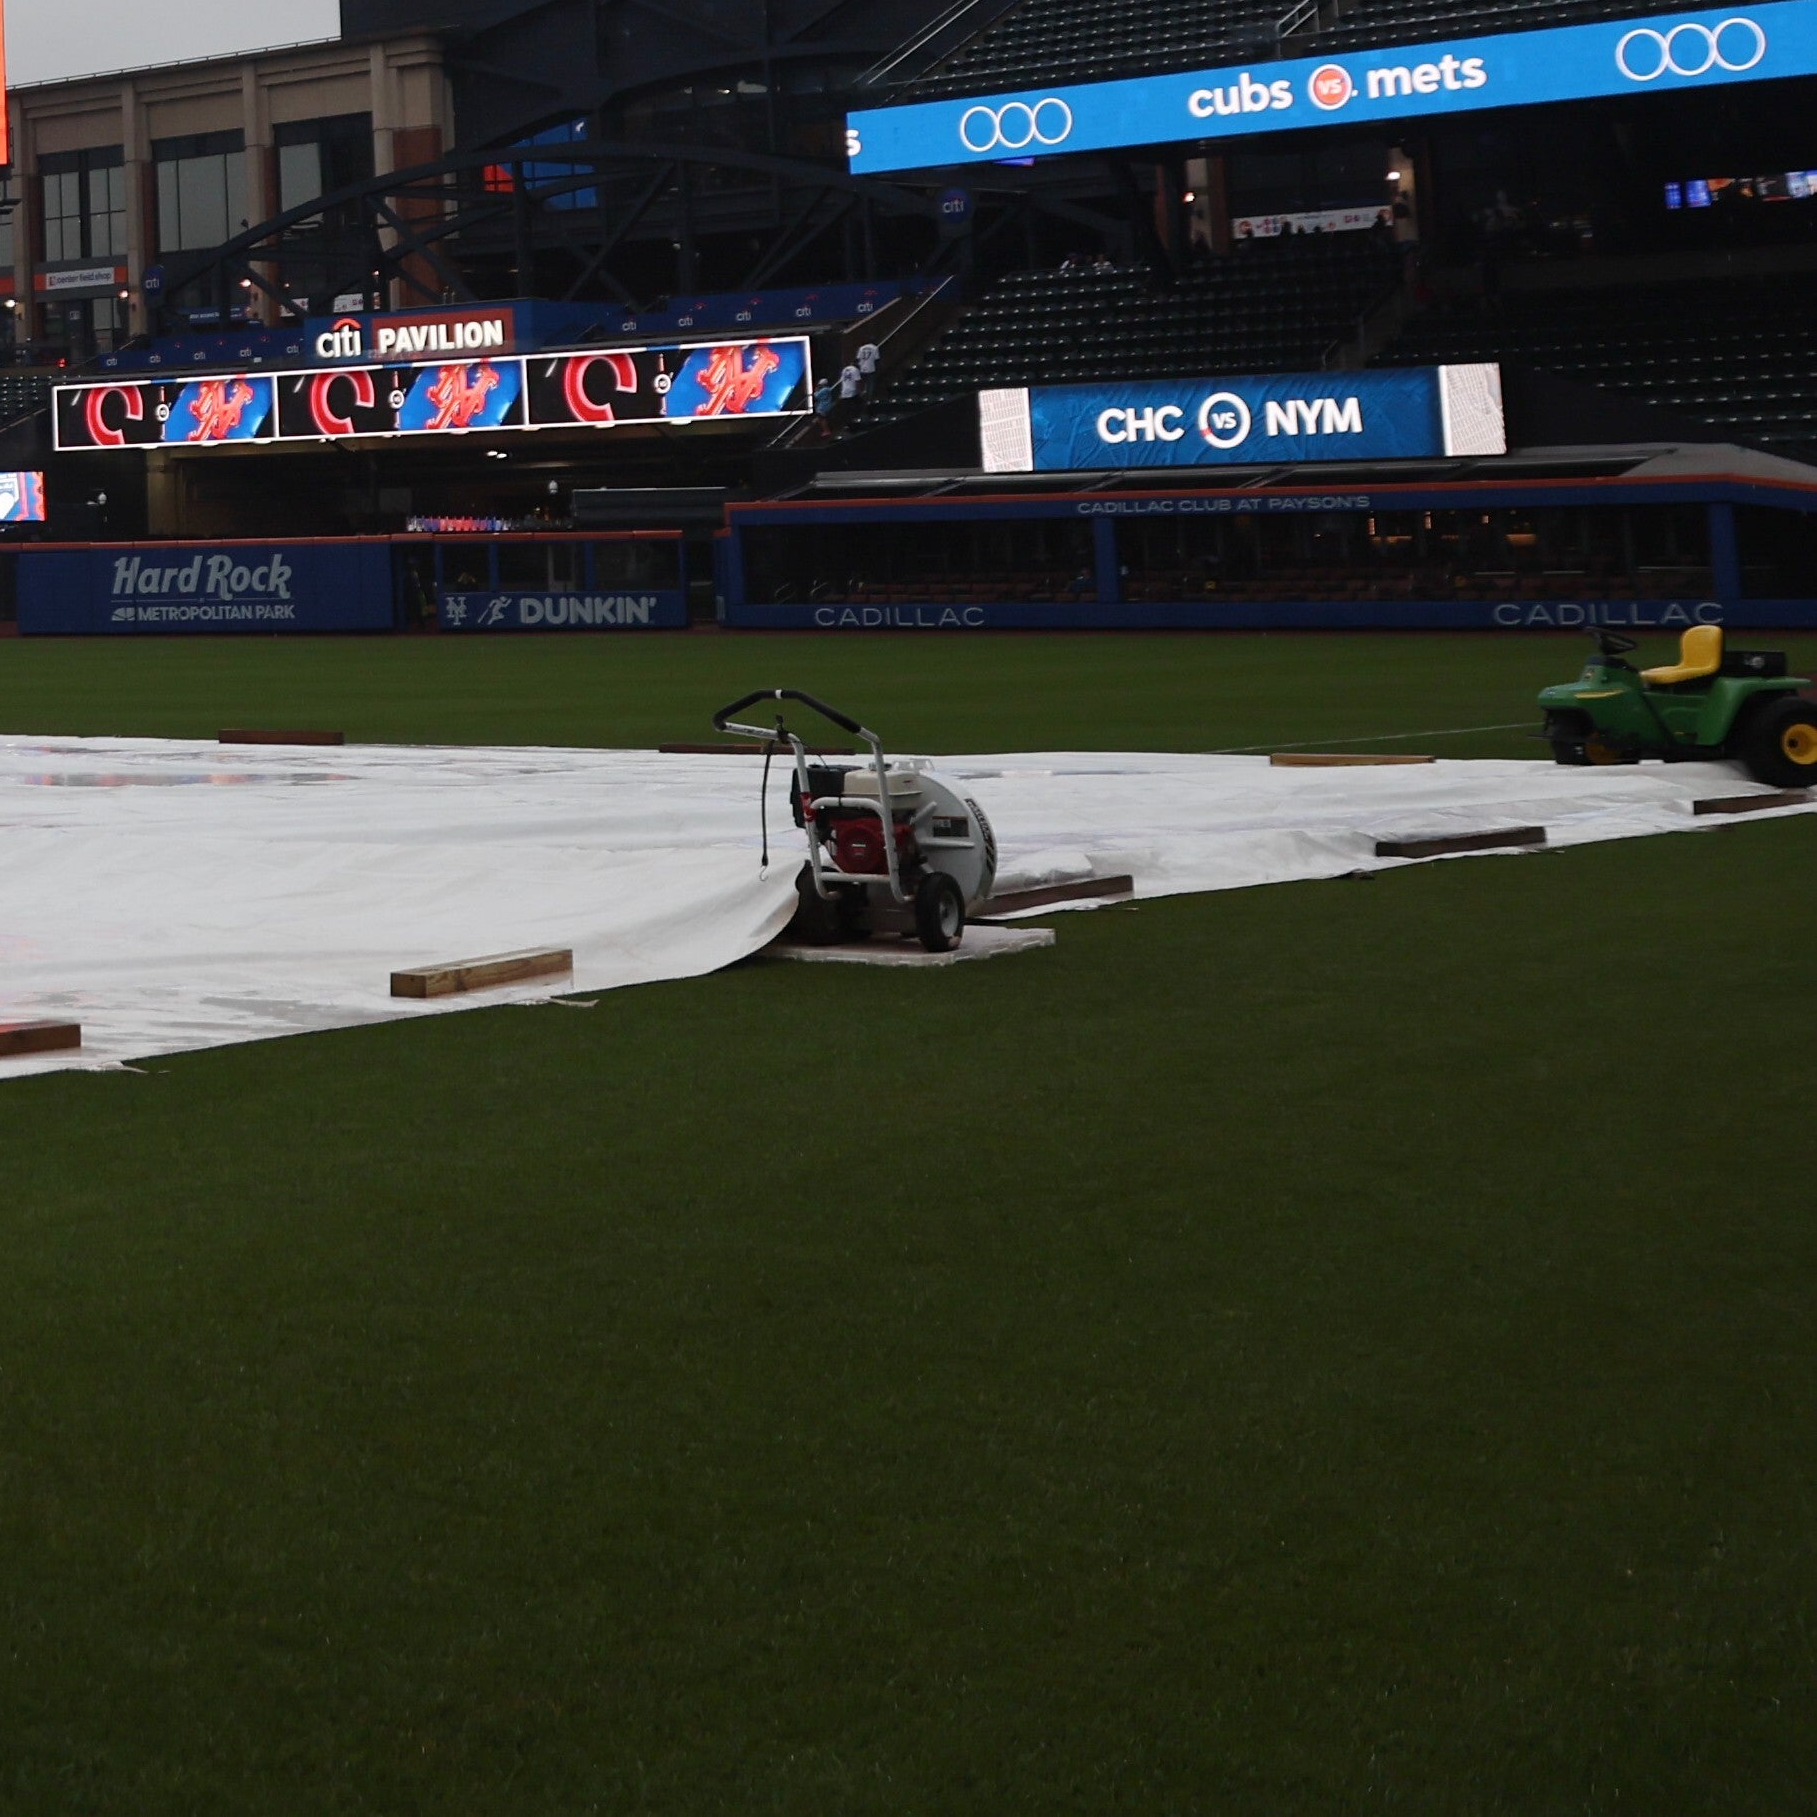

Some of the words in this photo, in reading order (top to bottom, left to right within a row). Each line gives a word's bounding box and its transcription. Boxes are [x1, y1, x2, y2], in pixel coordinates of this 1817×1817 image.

[1188, 70, 1291, 119] cubs
[1367, 53, 1486, 98] mets
[317, 326, 361, 358] citi
[379, 319, 503, 354] PAVILION
[1098, 406, 1183, 443] CHC
[1266, 397, 1362, 437] NYM
[1077, 500, 1174, 514] CADILLAC
[1179, 498, 1232, 511] CLUB
[1237, 497, 1259, 510] AT
[1269, 495, 1370, 510] PAYSON'S
[112, 556, 203, 596] Hard
[206, 554, 292, 600] Rock
[138, 605, 253, 621] METROPOLITAN
[256, 604, 295, 620] PARK
[520, 597, 656, 623] DUNKIN'
[815, 606, 984, 627] CADILLAC
[1493, 603, 1724, 626] CADILLAC
